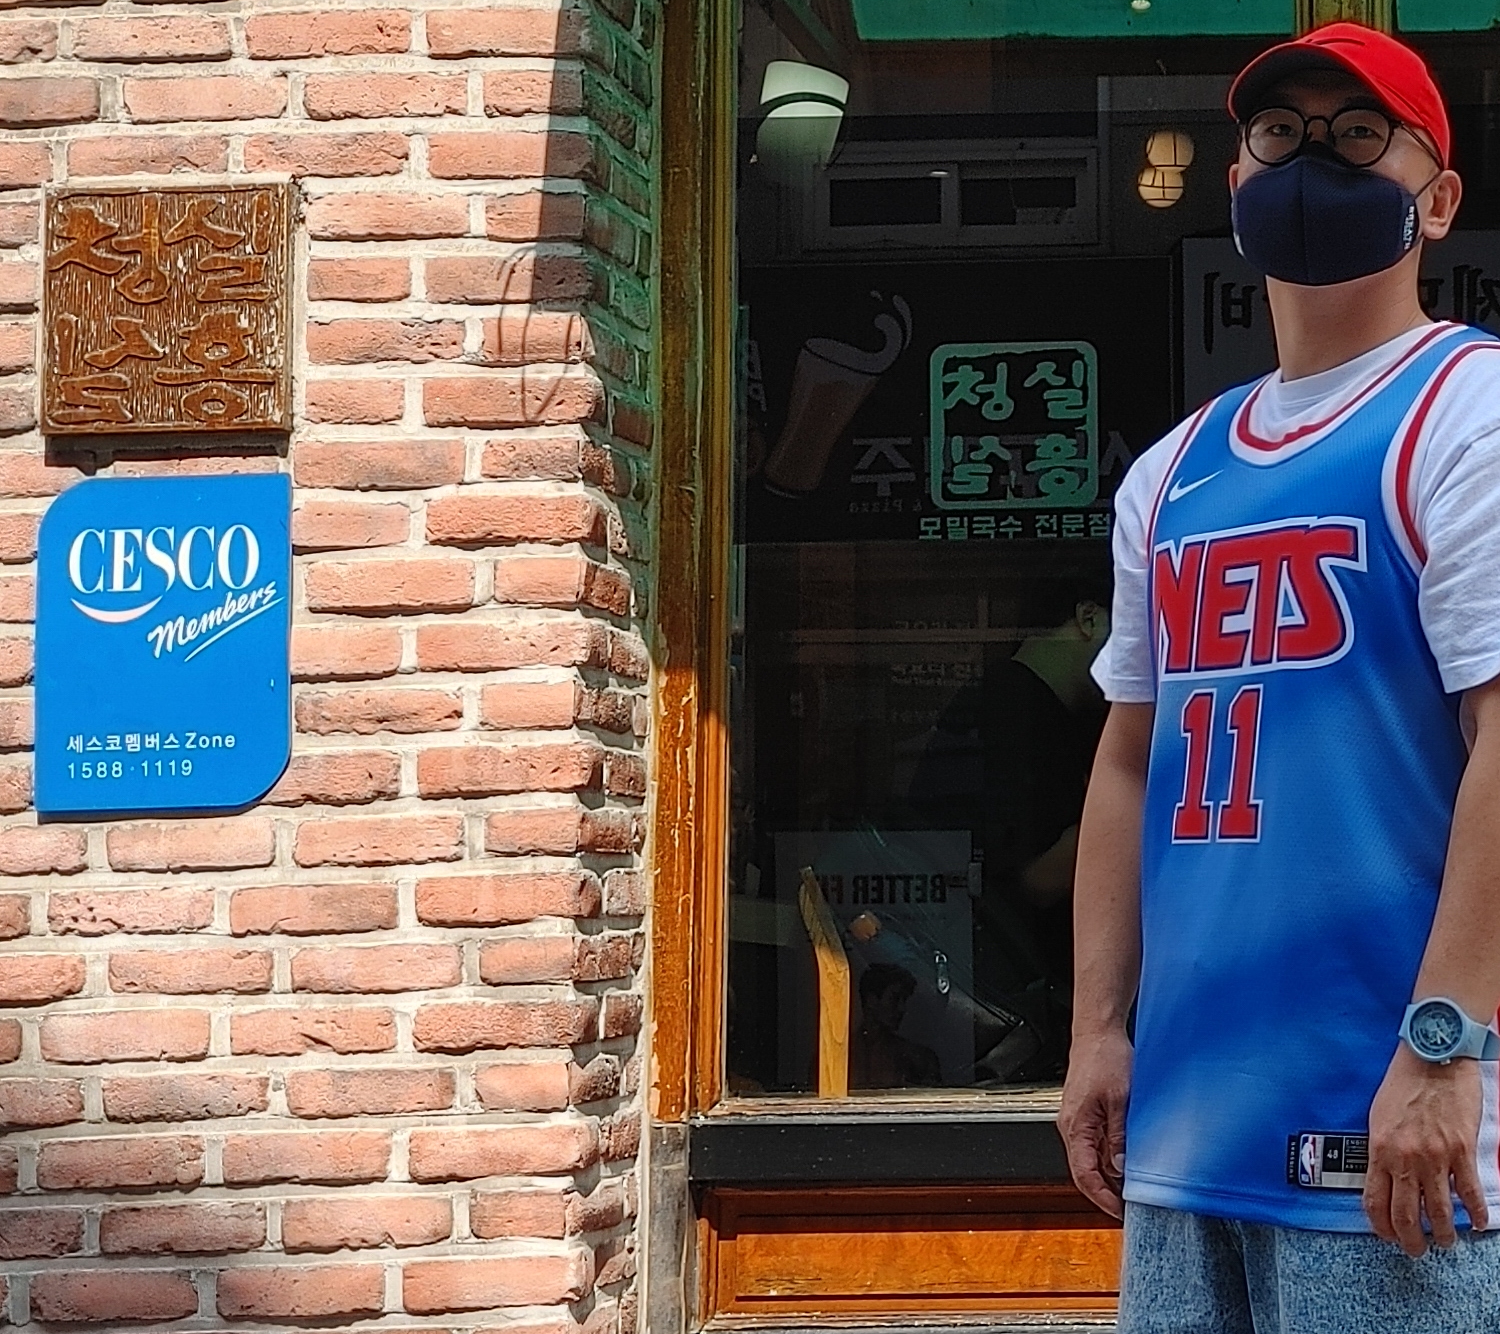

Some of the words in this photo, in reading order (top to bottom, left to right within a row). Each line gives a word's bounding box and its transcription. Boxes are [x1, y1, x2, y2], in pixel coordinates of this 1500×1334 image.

[68, 523, 260, 594] CESCO
[918, 514, 1024, 541] 모밀국수
[1034, 513, 1112, 539] 전문점
[147, 580, 278, 658] Members
[1153, 519, 1365, 679] NETS
[185, 731, 236, 749] Zone
[1171, 683, 1264, 844] 11
